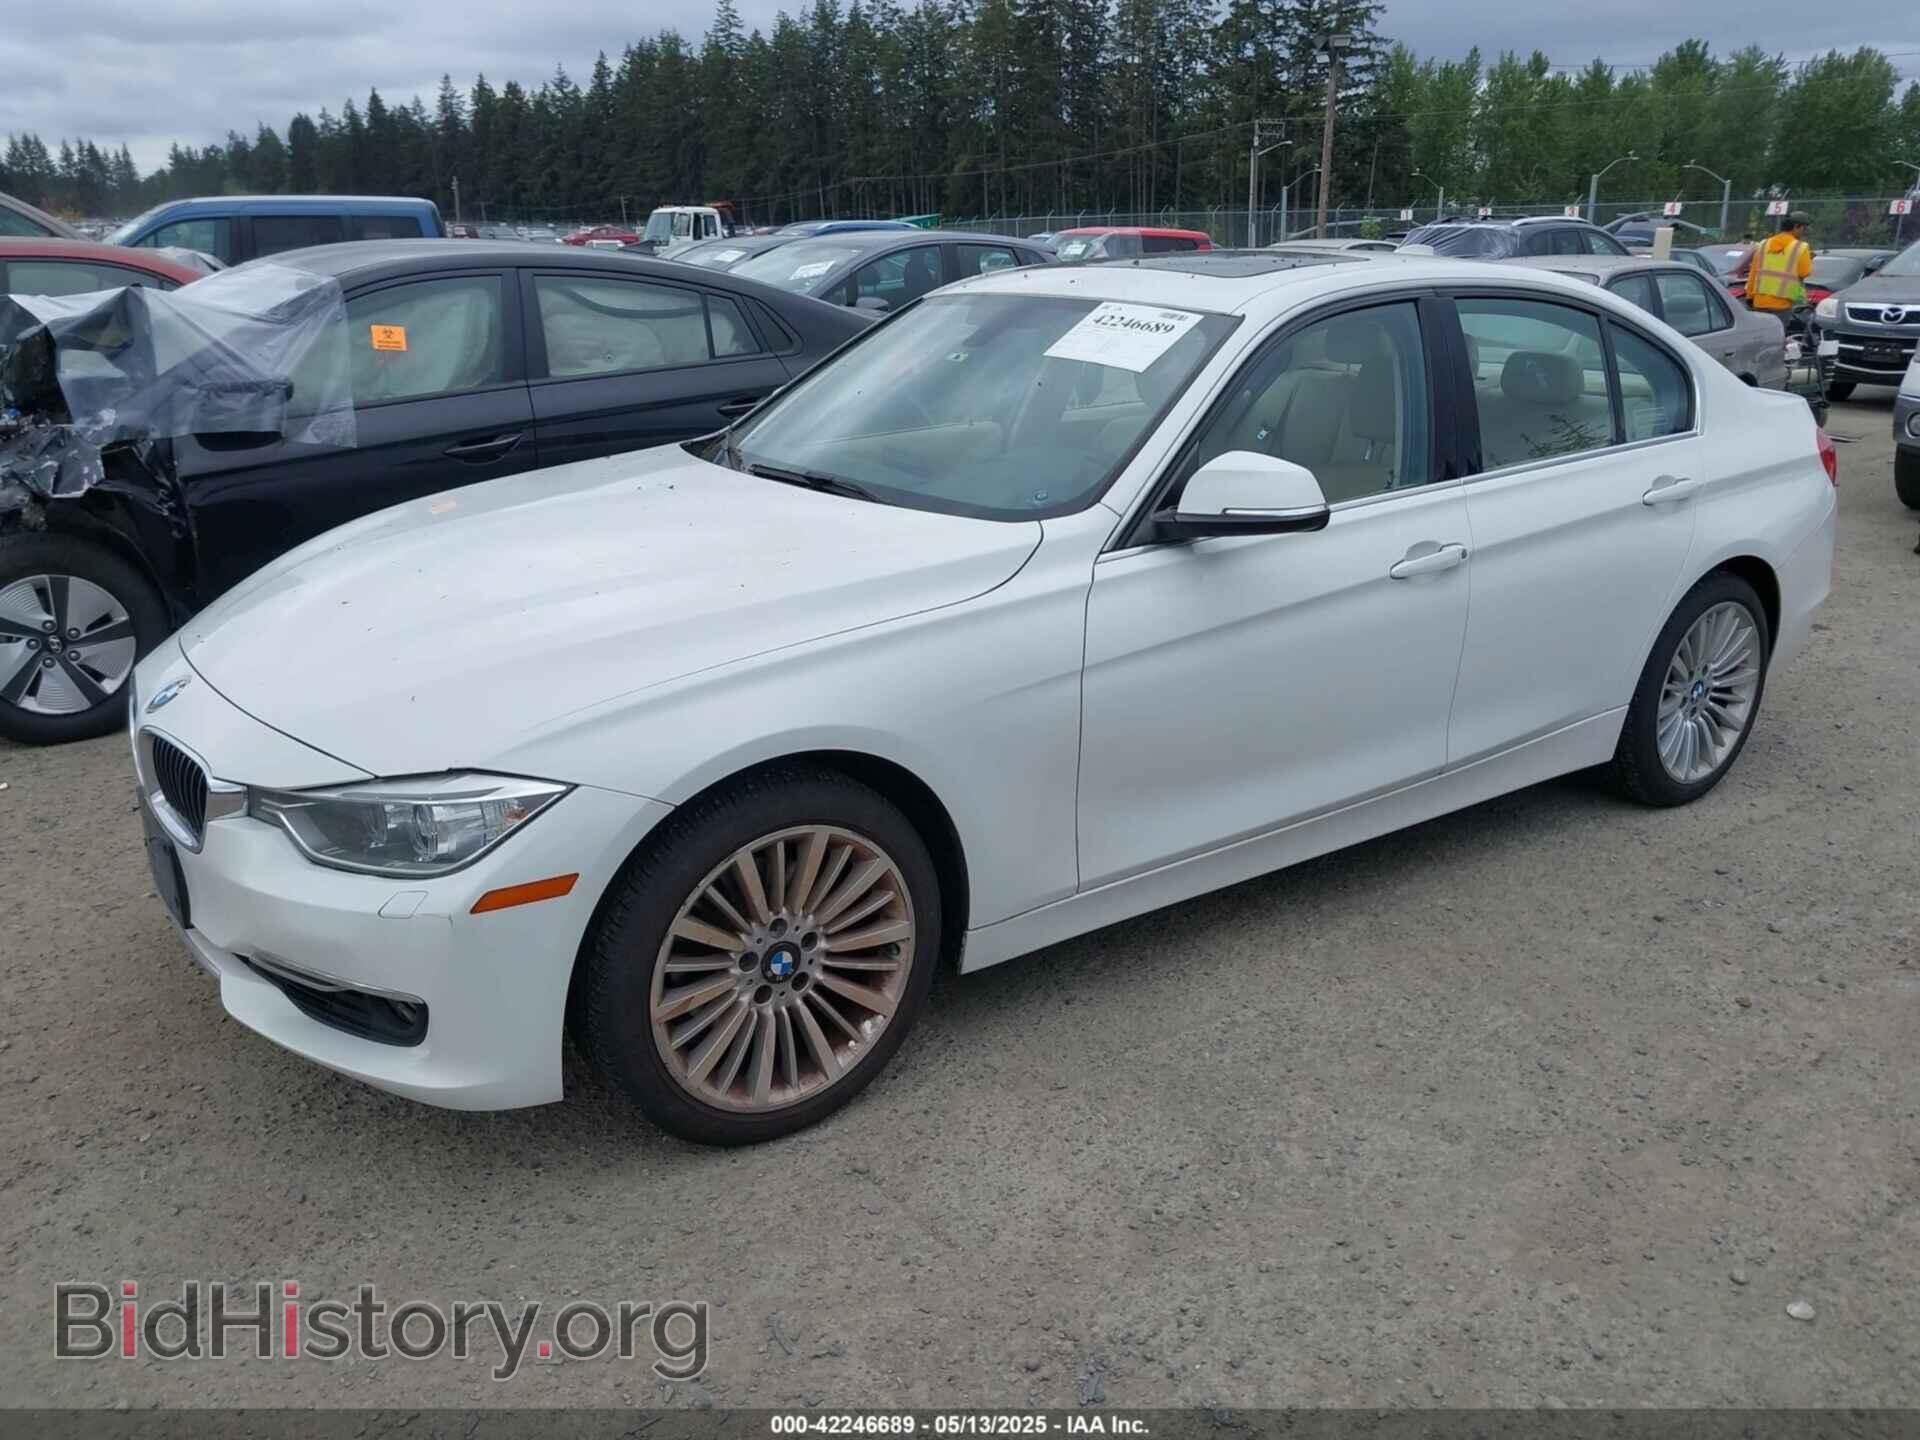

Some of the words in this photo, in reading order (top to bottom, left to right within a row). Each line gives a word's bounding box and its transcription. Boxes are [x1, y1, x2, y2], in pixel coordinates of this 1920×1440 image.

[1567, 207, 1575, 217] 3
[1668, 202, 1677, 214] 4
[1774, 201, 1783, 214] 5
[1896, 200, 1906, 213] 6
[1092, 314, 1176, 334] 42246689
